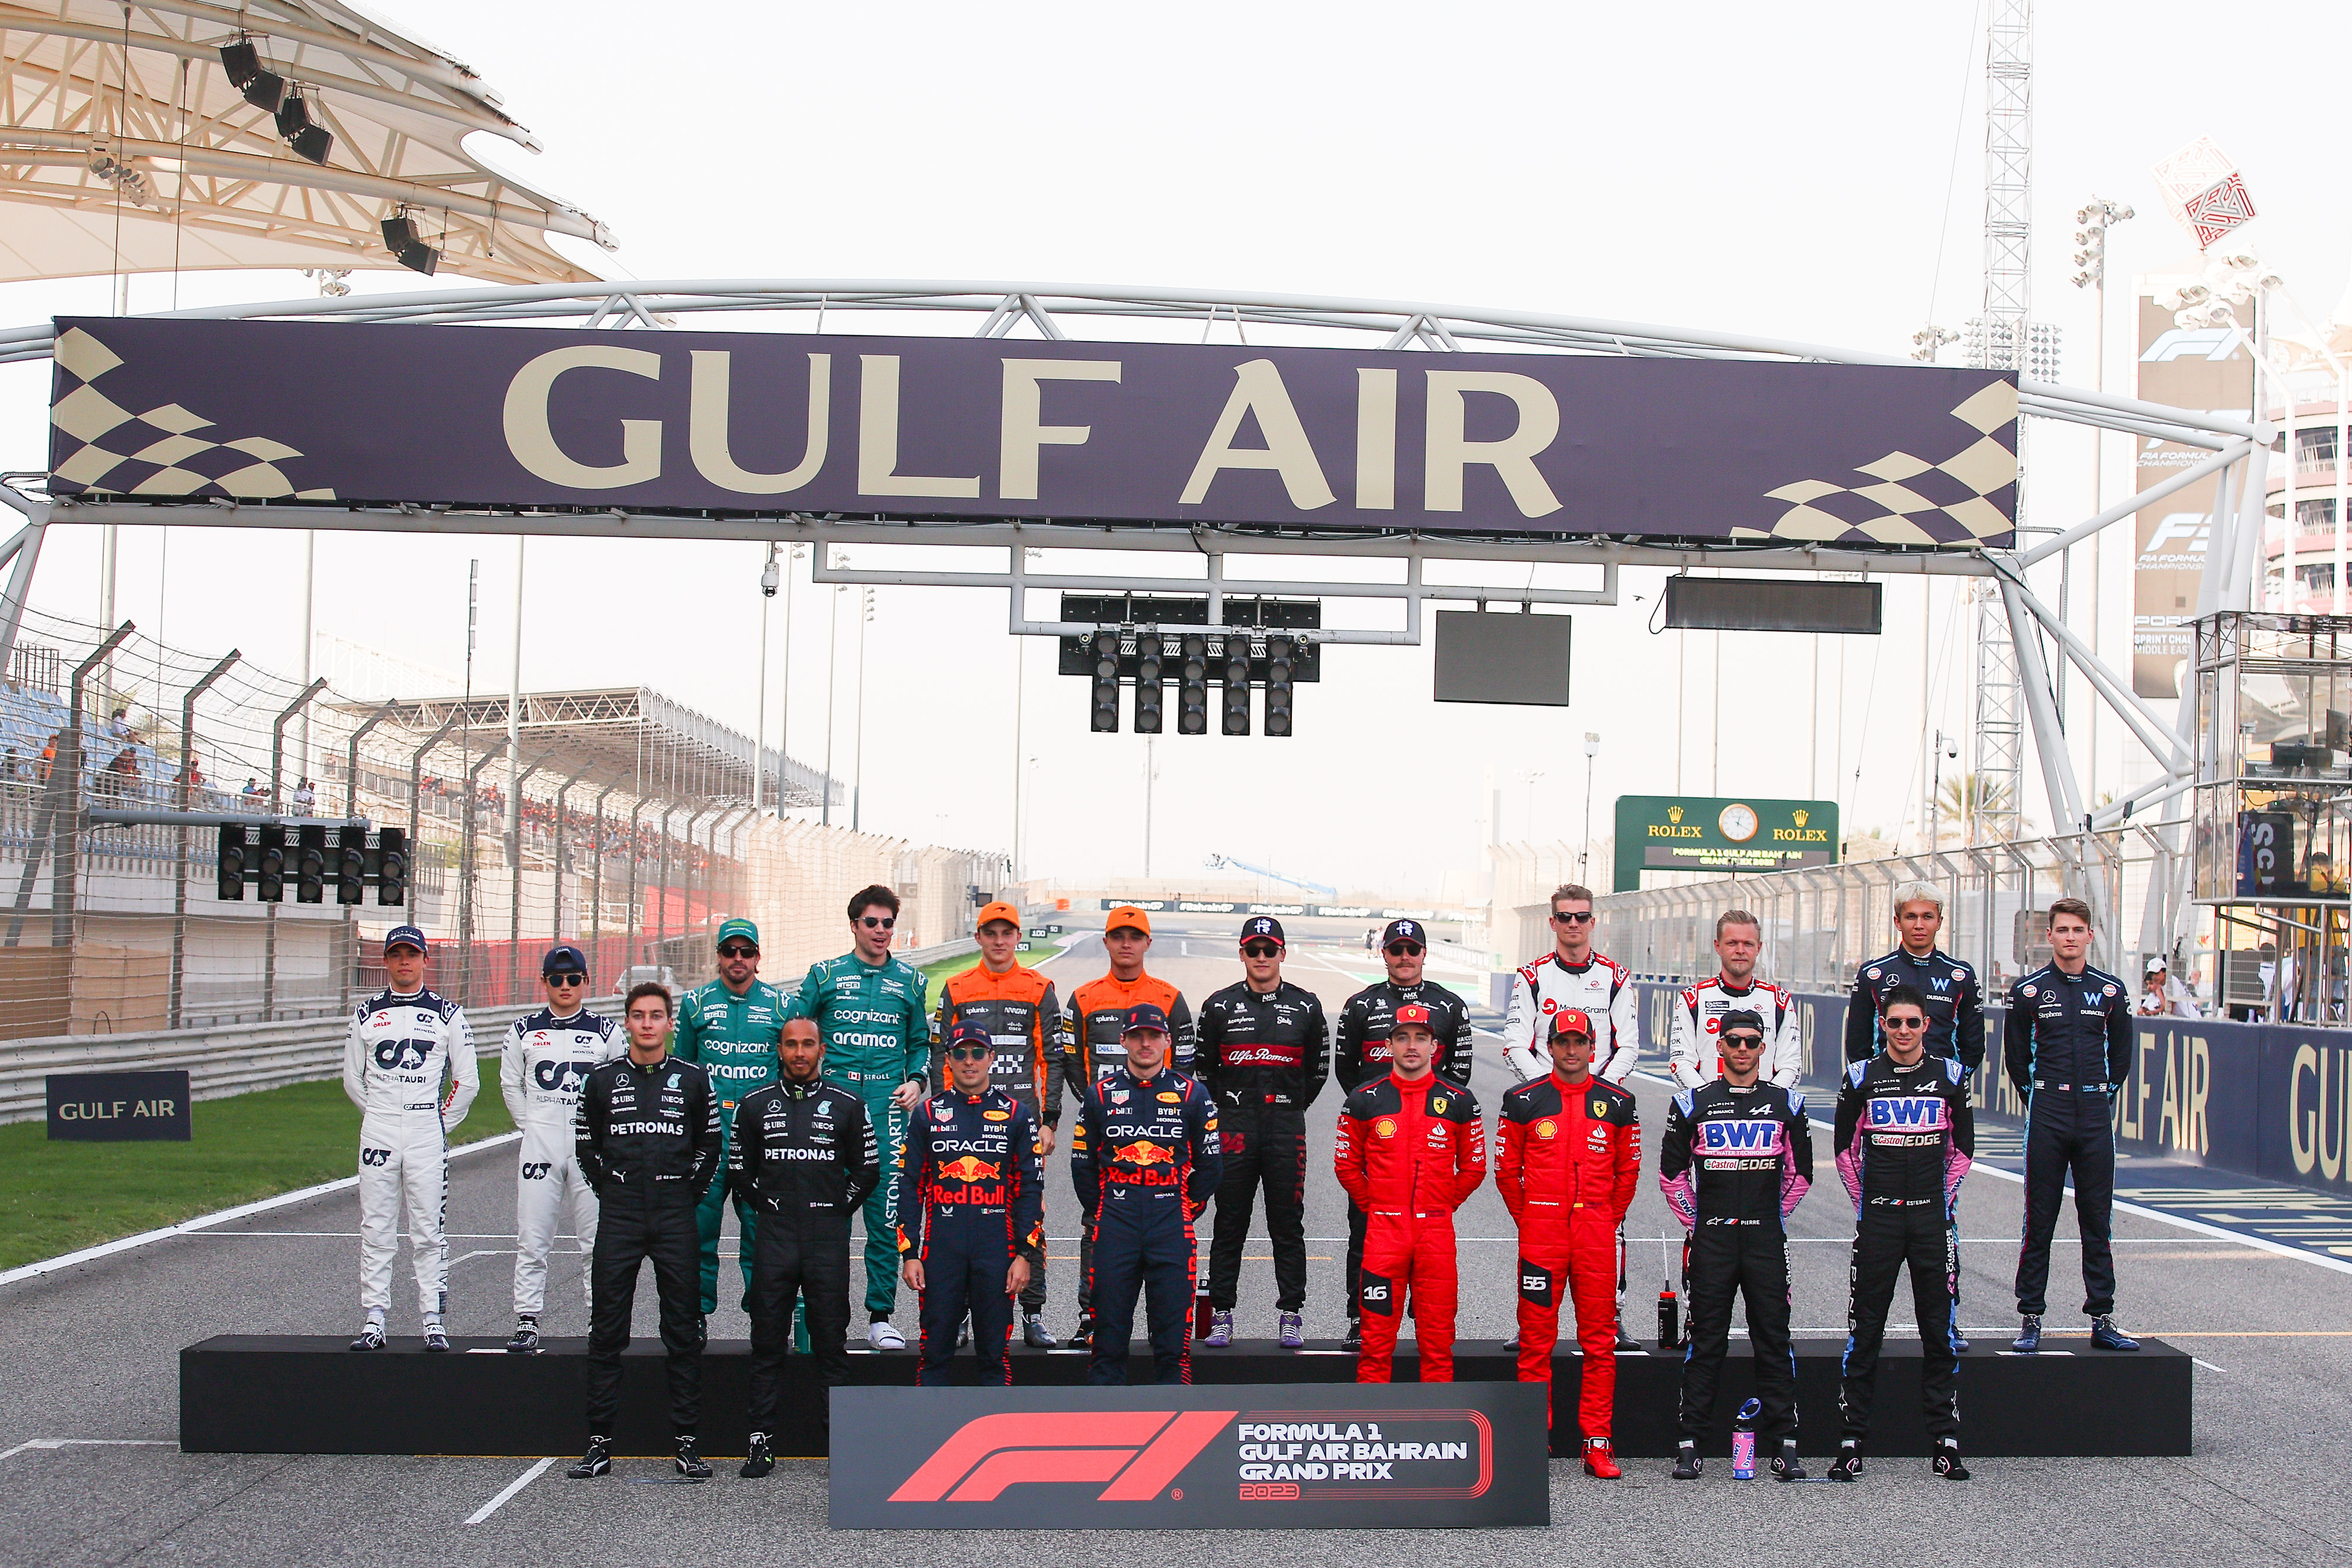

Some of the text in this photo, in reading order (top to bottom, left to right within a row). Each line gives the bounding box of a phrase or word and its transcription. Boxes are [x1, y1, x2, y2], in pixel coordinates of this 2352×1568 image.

[503, 346, 1563, 517] GULF AIR
[2134, 634, 2167, 645] SPRINT
[2134, 644, 2168, 655] MIDDLE
[1648, 825, 1702, 838] ROLEX
[1773, 828, 1827, 841] ROLEX
[1672, 847, 1715, 856] FORMULA
[1747, 850, 1760, 858] AIR
[1179, 901, 1234, 912] #BahrainGP
[1250, 904, 1304, 915] #BahrainGP
[1318, 906, 1371, 917] #BahrainGP
[837, 982, 860, 990] JCB
[1926, 995, 1953, 1003] DURACELL
[703, 1004, 728, 1012] aramco
[834, 1008, 900, 1024] cognizant
[833, 1032, 897, 1048] aramco
[704, 1039, 770, 1055] cognizant
[1228, 1048, 1294, 1065] Alfa Romeo
[706, 1063, 768, 1079] aramco
[376, 1074, 426, 1084] ALPHATAURI
[662, 1095, 684, 1104] INEOS
[2159, 1030, 2210, 1156] AIR
[536, 1095, 578, 1106] ALPHATAU
[59, 1099, 175, 1121] GULF AIR
[1107, 1108, 1125, 1116] Mobil
[1158, 1107, 1181, 1116] BYBIT
[1872, 1099, 1941, 1125] BWT
[610, 1122, 684, 1135] PETRONAS
[811, 1122, 834, 1131] INEOS
[984, 1124, 1008, 1132] BYBIT
[1106, 1125, 1183, 1138] ORACLE
[1587, 1136, 1608, 1145] Santander
[1707, 1123, 1776, 1148] BWT
[1878, 1134, 1941, 1147] Castrol EDGE
[931, 1140, 1008, 1154] ORACLE
[765, 1148, 835, 1161] PETRONAS
[884, 1096, 902, 1229] ASTON MARTIN
[1711, 1159, 1776, 1171] Castrol EDGE
[1107, 1166, 1179, 1186] Red Bull
[1951, 1175, 1966, 1194] BWT
[933, 1184, 1005, 1205] Red Bull
[1679, 1198, 1696, 1218] BWT
[1523, 1275, 1546, 1290] 55
[1364, 1286, 1387, 1300] 16
[1239, 1424, 1382, 1441] FORMULA 1
[1240, 1443, 1467, 1460] GULF AIR BAHRAIN
[1240, 1463, 1393, 1480] GRAND PRIX
[1240, 1483, 1300, 1500] 2023
